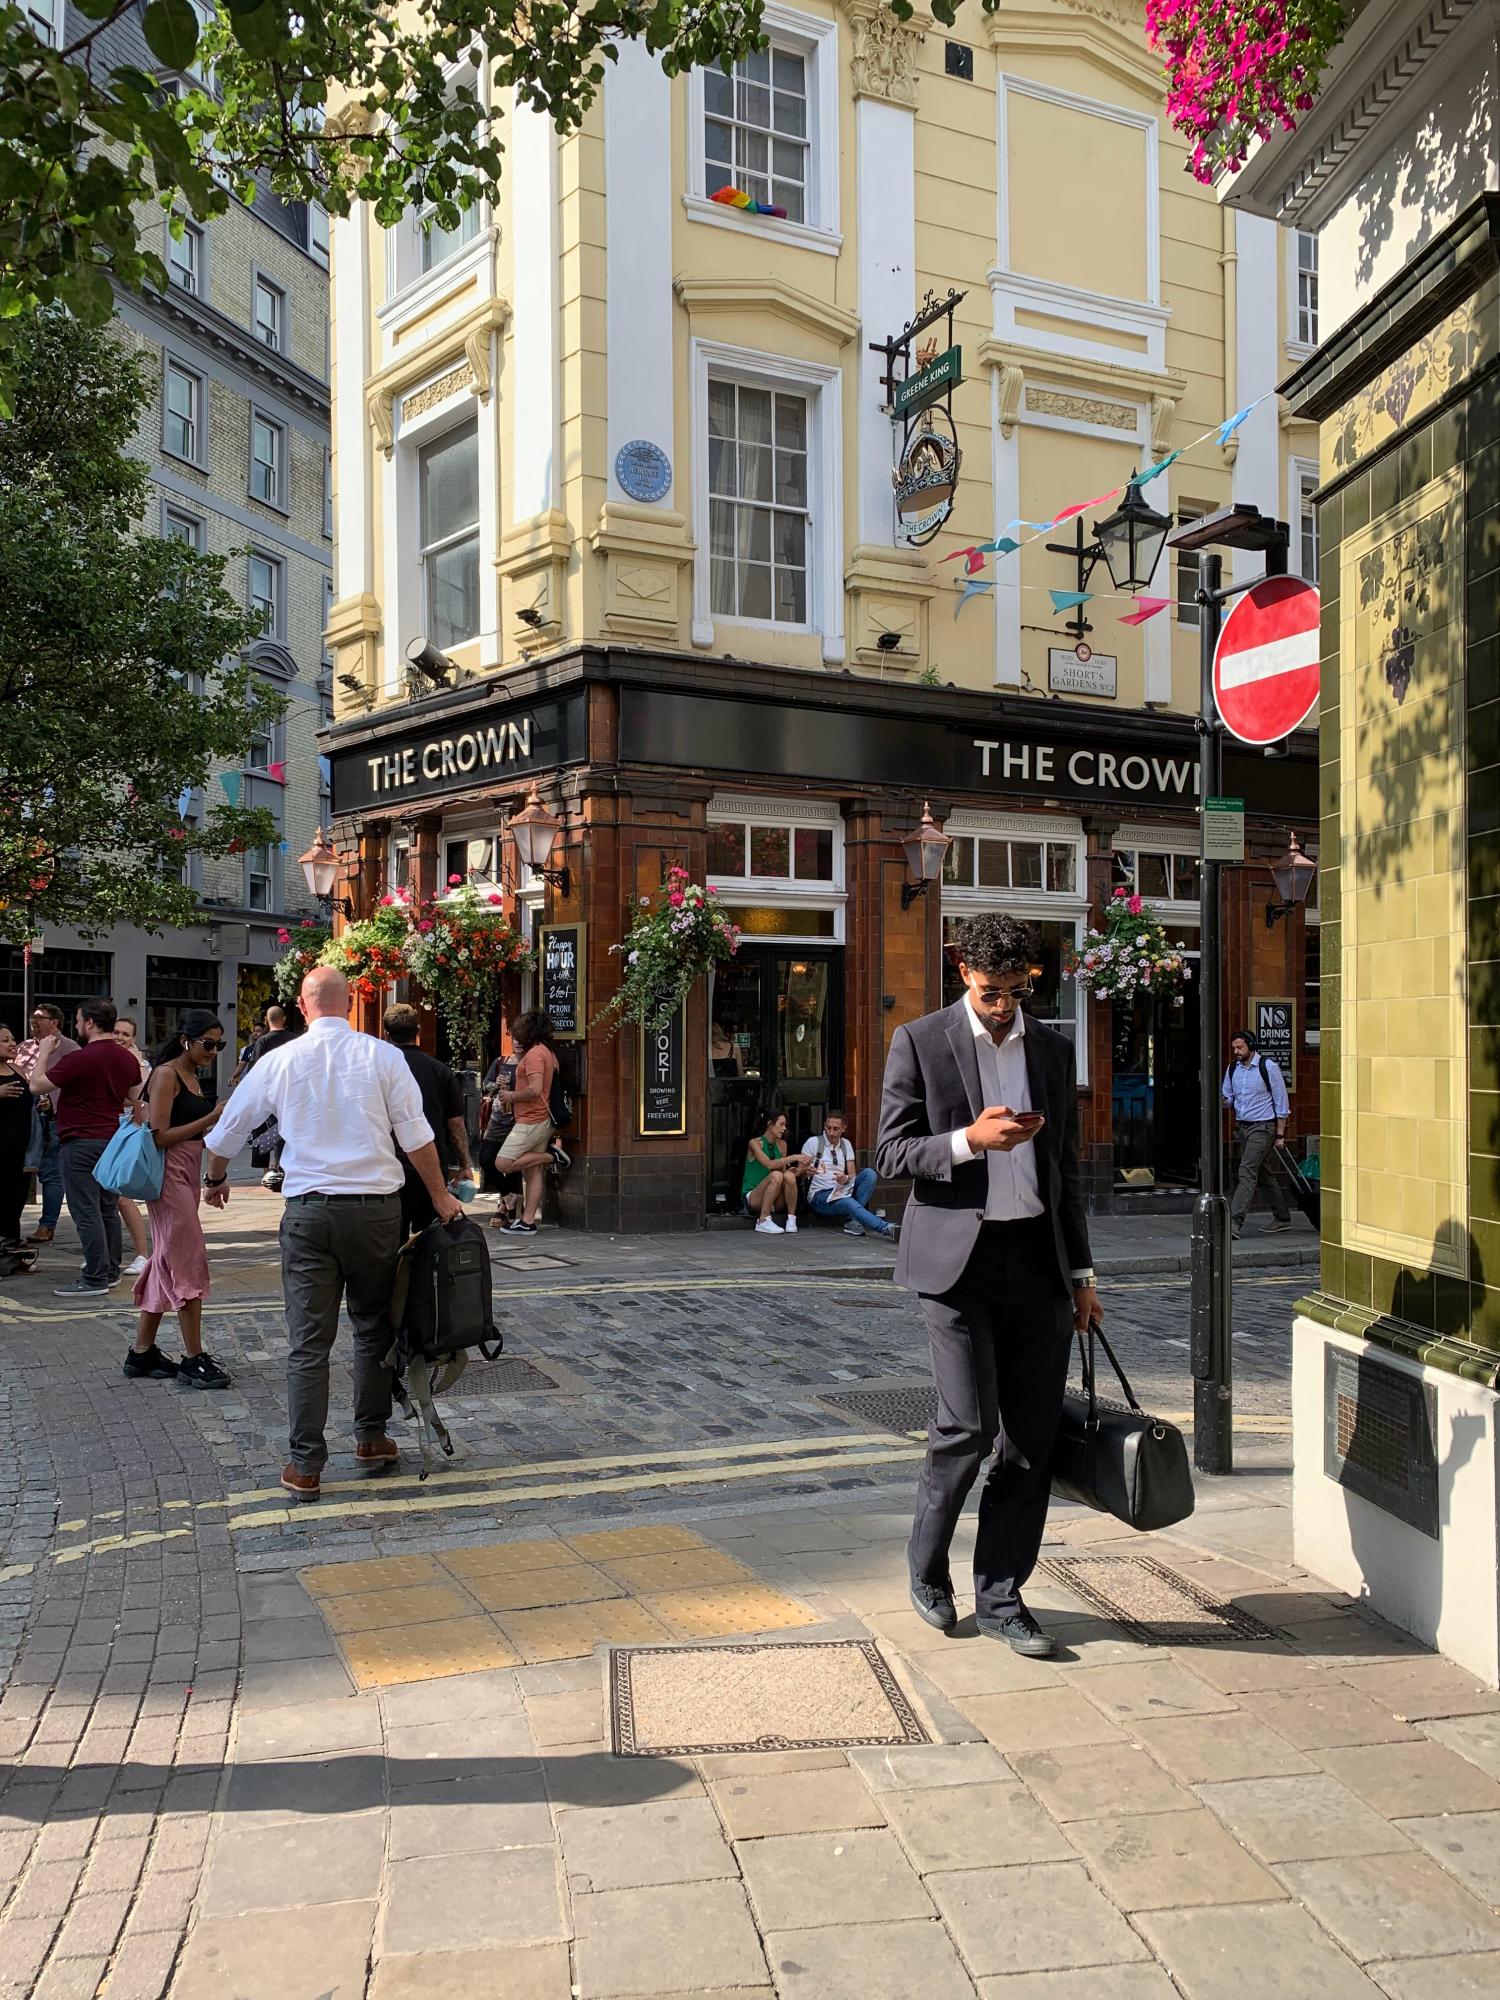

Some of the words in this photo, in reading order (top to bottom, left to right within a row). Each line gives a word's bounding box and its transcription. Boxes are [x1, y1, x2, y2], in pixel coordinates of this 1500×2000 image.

[901, 376, 928, 402] GREENE
[930, 362, 949, 382] KING
[906, 524, 917, 533] THE
[918, 506, 942, 532] CROWN
[1063, 668, 1104, 681] SHORT'S
[1052, 676, 1097, 689] GARDENS
[368, 748, 416, 792] THE
[422, 718, 530, 780] CROWN
[973, 740, 1054, 782] THE
[548, 936, 572, 950] Happy
[546, 952, 574, 969] HOUR
[550, 986, 556, 999] 2
[549, 1005, 570, 1014] PERONI
[1260, 1029, 1290, 1038] DRINKS
